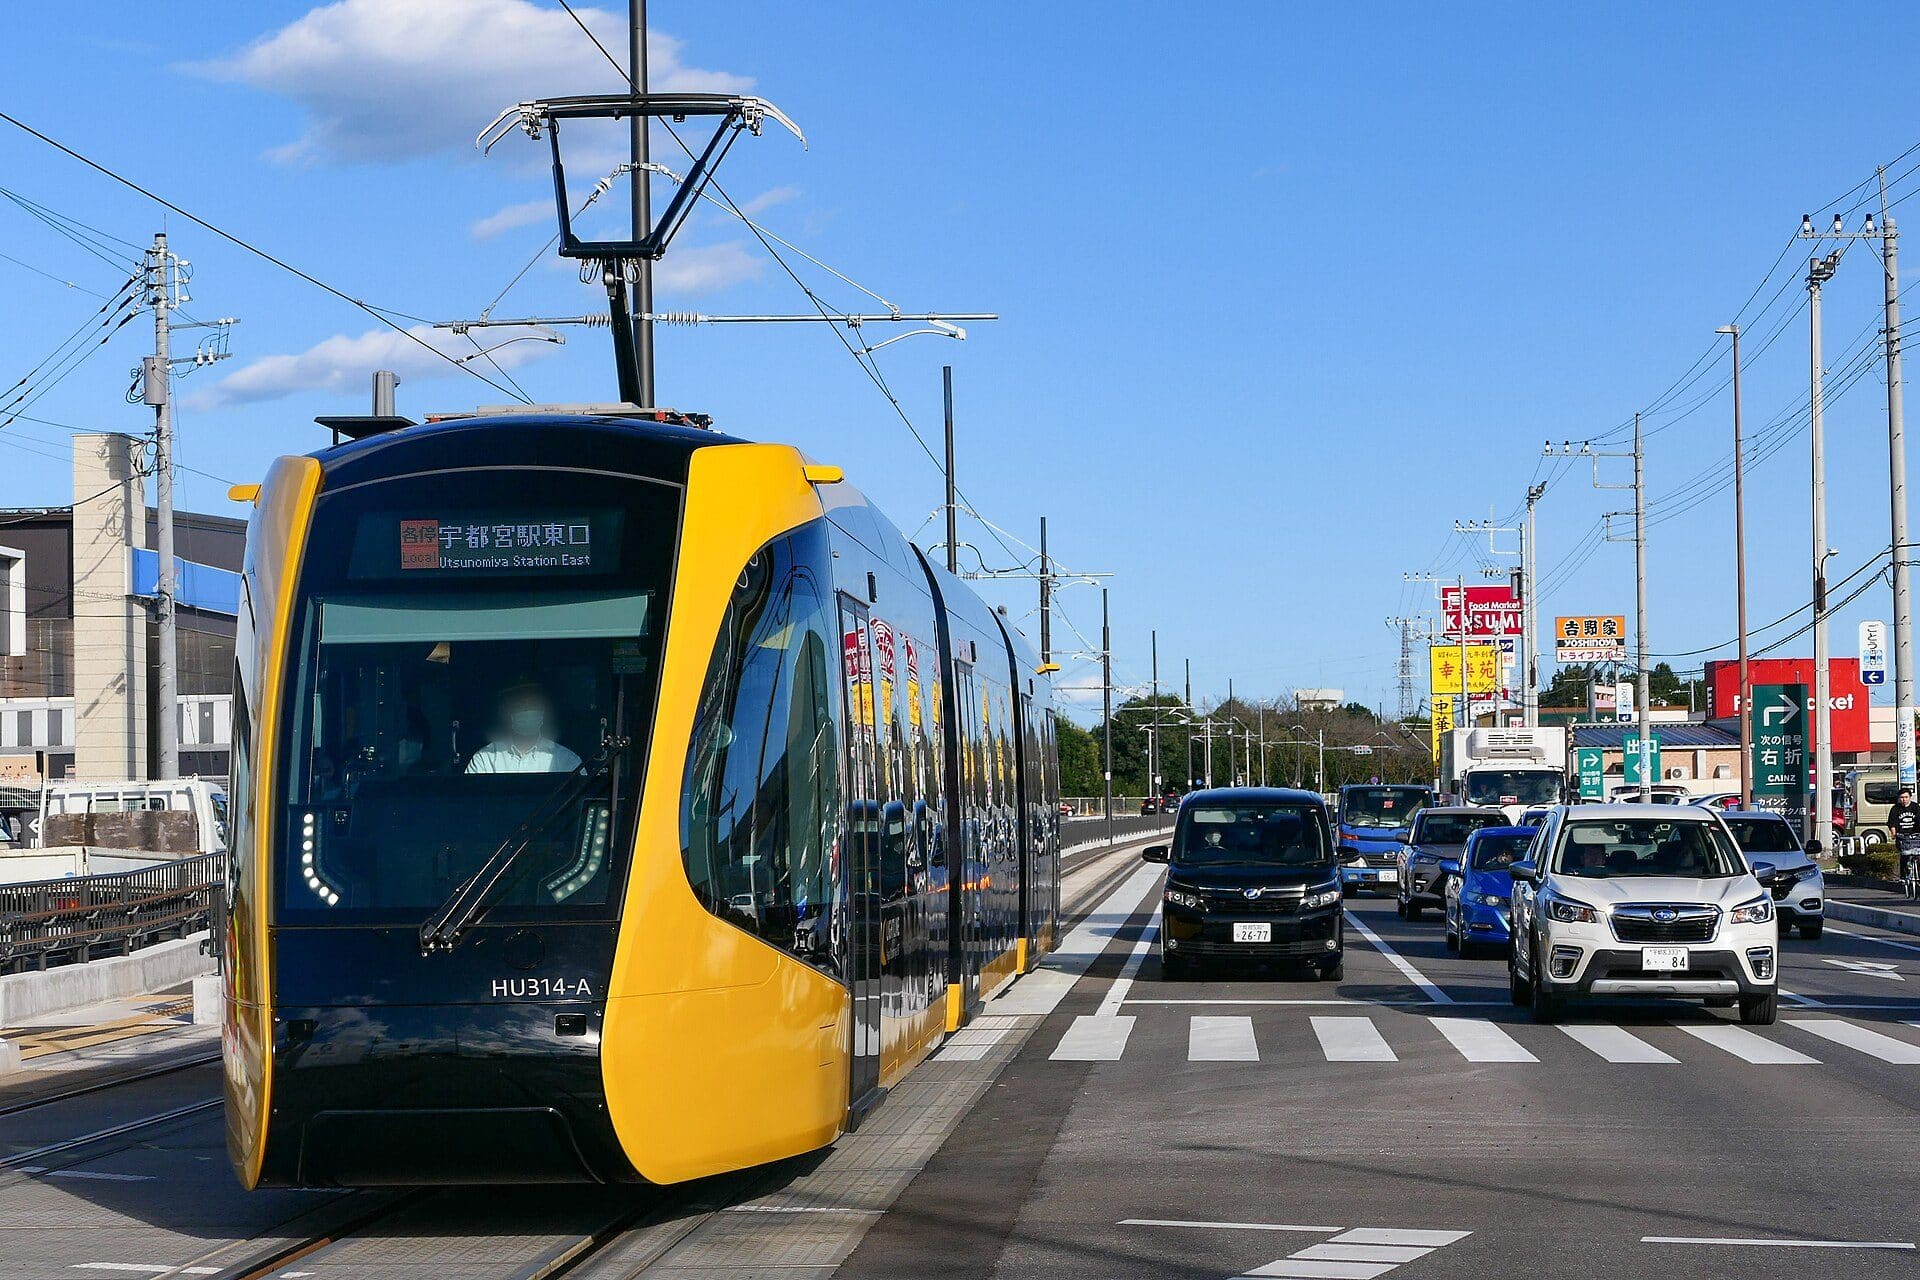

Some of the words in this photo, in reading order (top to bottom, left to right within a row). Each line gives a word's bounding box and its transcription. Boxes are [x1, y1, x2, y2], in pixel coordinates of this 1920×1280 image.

[438, 524, 590, 549] 宇都宮駅東口
[402, 552, 437, 564] Local
[439, 556, 509, 569] Utsunomiya
[513, 555, 558, 567] Station
[562, 553, 590, 566] East
[1468, 601, 1490, 609] Food
[1491, 600, 1520, 609] Market
[1446, 613, 1522, 630] KASUMI
[1760, 734, 1802, 746] 次の信号
[1760, 748, 1802, 766] 右折
[1767, 774, 1796, 782] CAINZ
[1758, 797, 1789, 806] カインズ
[492, 978, 592, 997] HU314-A
